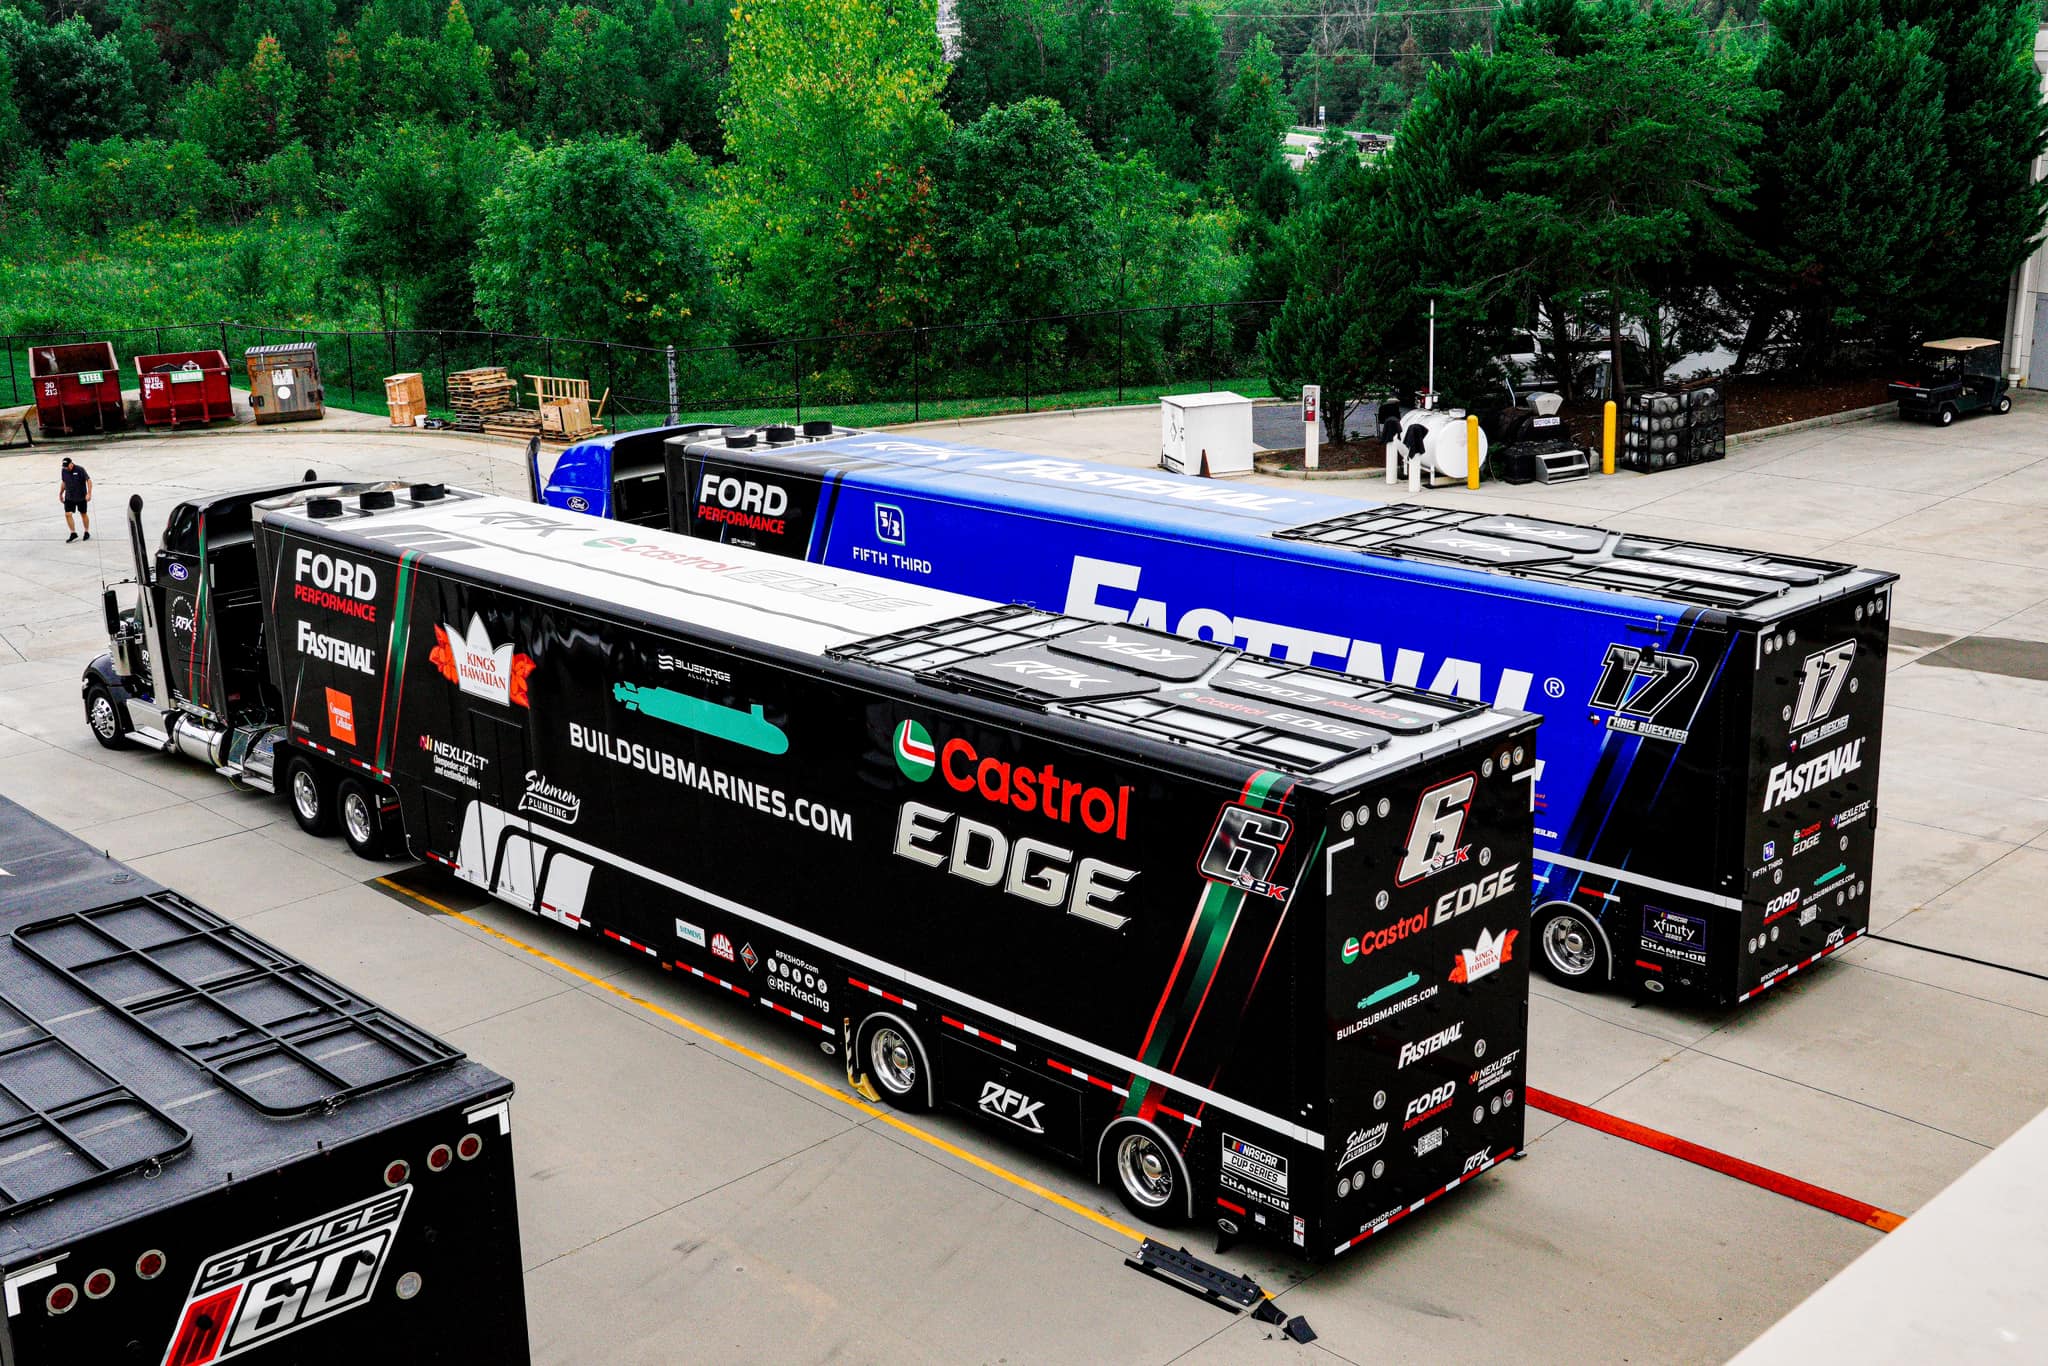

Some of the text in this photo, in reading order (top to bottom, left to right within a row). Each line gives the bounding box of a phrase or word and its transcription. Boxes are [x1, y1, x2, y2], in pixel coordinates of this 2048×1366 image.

[700, 474, 788, 517] FORD
[697, 505, 786, 535] PERFORMANCE
[295, 548, 377, 601] FORD
[621, 545, 743, 573] Castrol
[853, 546, 932, 575] FIFTH THIRD
[294, 584, 377, 623] PERFORMANCE
[297, 619, 376, 676] FASTENAL
[467, 652, 496, 673] KING'S
[460, 663, 507, 691] HAWAIIAN
[675, 658, 732, 683] BLUEFORGE
[687, 672, 719, 686] ALLIANCE
[1588, 643, 1698, 719] 17
[1789, 638, 1857, 733] 17
[1196, 696, 1374, 740] Castrol EDGE
[1606, 716, 1689, 741] CHRIS BUESCHER
[433, 739, 489, 771] NEXLIZET
[569, 721, 853, 841] BUILDSUBMARINES.COM
[941, 738, 1132, 840] Castrol
[1763, 738, 1862, 813] FASTENAL
[528, 797, 567, 819] PLUMBING
[1199, 803, 1293, 883] 6
[1396, 772, 1477, 886] 6
[1792, 832, 1821, 857] EDGE
[893, 801, 1142, 930] EDGE
[1361, 862, 1521, 956] Castrol EDGE
[1765, 887, 1800, 918] FORD
[679, 925, 702, 941] SIEMENS
[711, 933, 733, 955] MAC
[1653, 919, 1695, 941] xfinity
[1825, 925, 1845, 947] RFK
[775, 950, 819, 974] RFKSHOP.com
[1641, 940, 1706, 963] CHAMPION
[767, 975, 830, 1013] @RFKracing
[1336, 985, 1439, 1041] BUILDSUBMARINES.COM
[1398, 1021, 1464, 1070] FASTENAL
[1479, 1049, 1520, 1079] NEXLIZET
[977, 1080, 1046, 1130] RFK
[1405, 1080, 1456, 1121] FORD
[1231, 1155, 1279, 1183] CUP SERIES
[1242, 1143, 1278, 1168] NASCAR
[1462, 1145, 1492, 1175] RFK
[1220, 1174, 1290, 1210] CHAMPION
[200, 1195, 402, 1290] STAGE
[228, 1234, 387, 1348] 60
